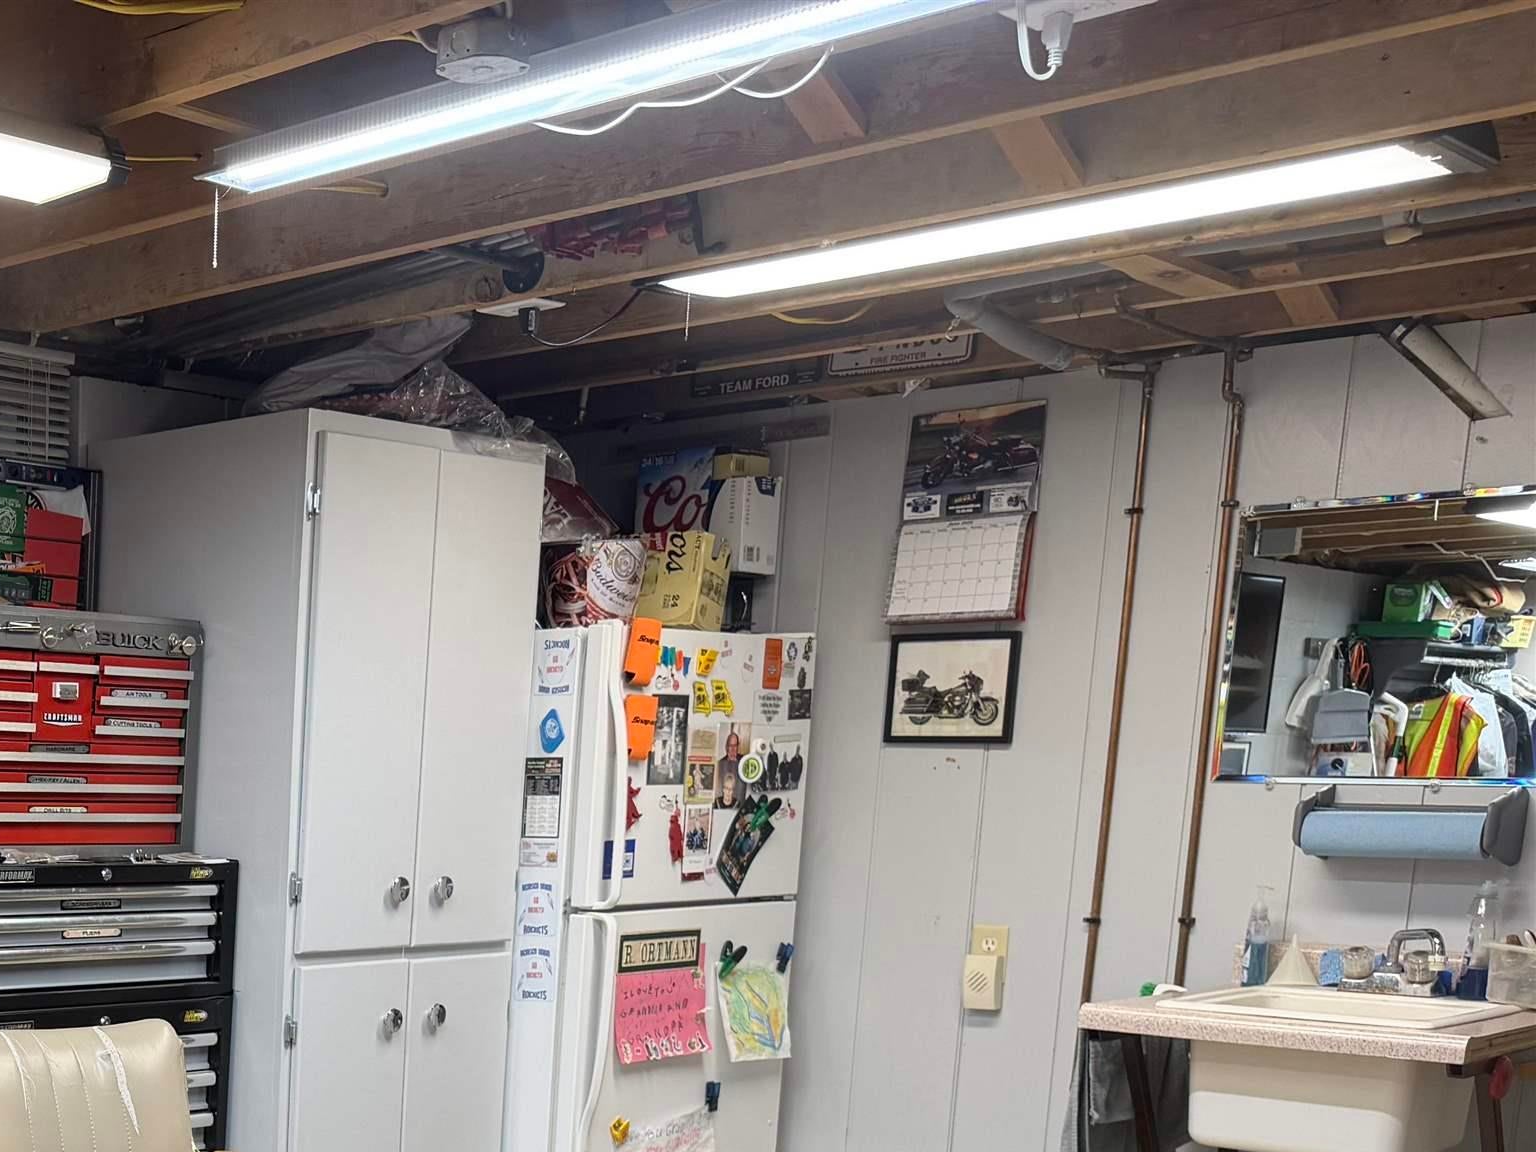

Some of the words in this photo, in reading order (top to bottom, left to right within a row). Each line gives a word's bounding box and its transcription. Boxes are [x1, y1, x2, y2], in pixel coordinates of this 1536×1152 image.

[870, 356, 888, 365] FIRE
[890, 351, 927, 363] FIGHTER
[720, 378, 752, 395] TEAM
[755, 374, 789, 389] FORD
[95, 629, 163, 651] BUICK
[43, 712, 83, 722] CRAFTSMAN
[641, 939, 696, 963] ORTMANN
